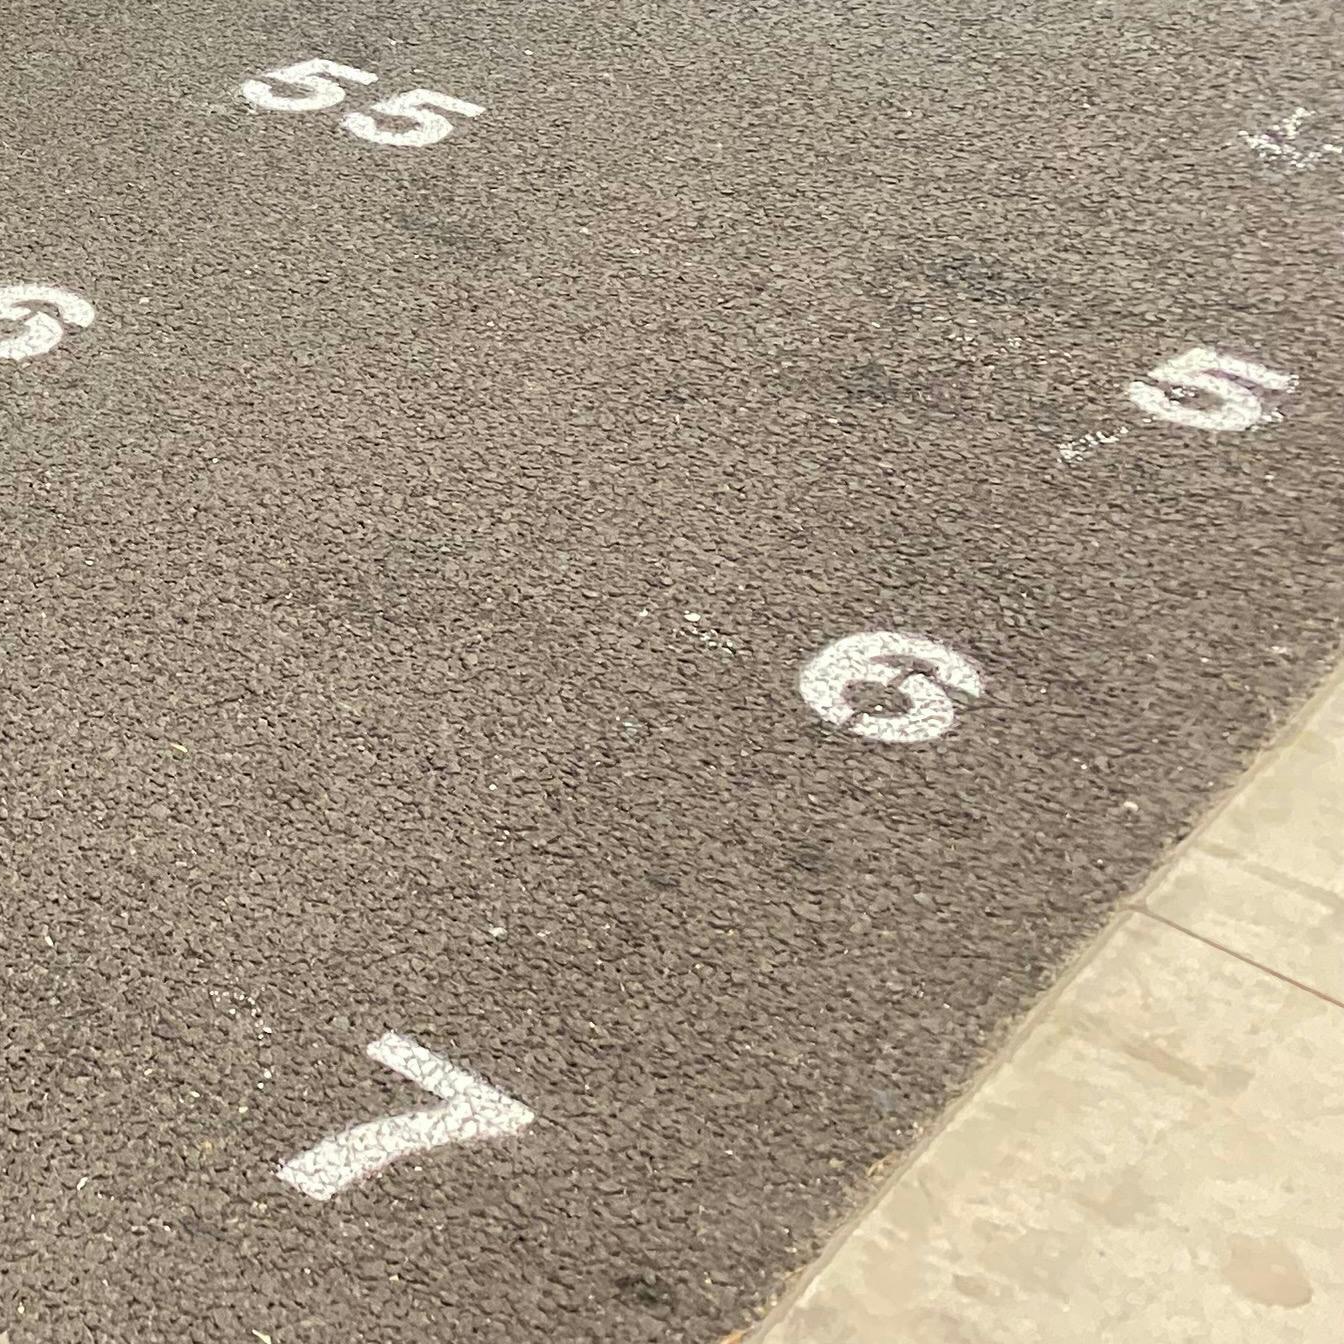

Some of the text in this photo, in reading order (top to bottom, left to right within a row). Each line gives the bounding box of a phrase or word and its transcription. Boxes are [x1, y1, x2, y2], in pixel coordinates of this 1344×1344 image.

[242, 59, 484, 146] 55
[1127, 348, 1290, 430] 5
[800, 632, 983, 741] 6
[278, 1033, 534, 1200] 7
